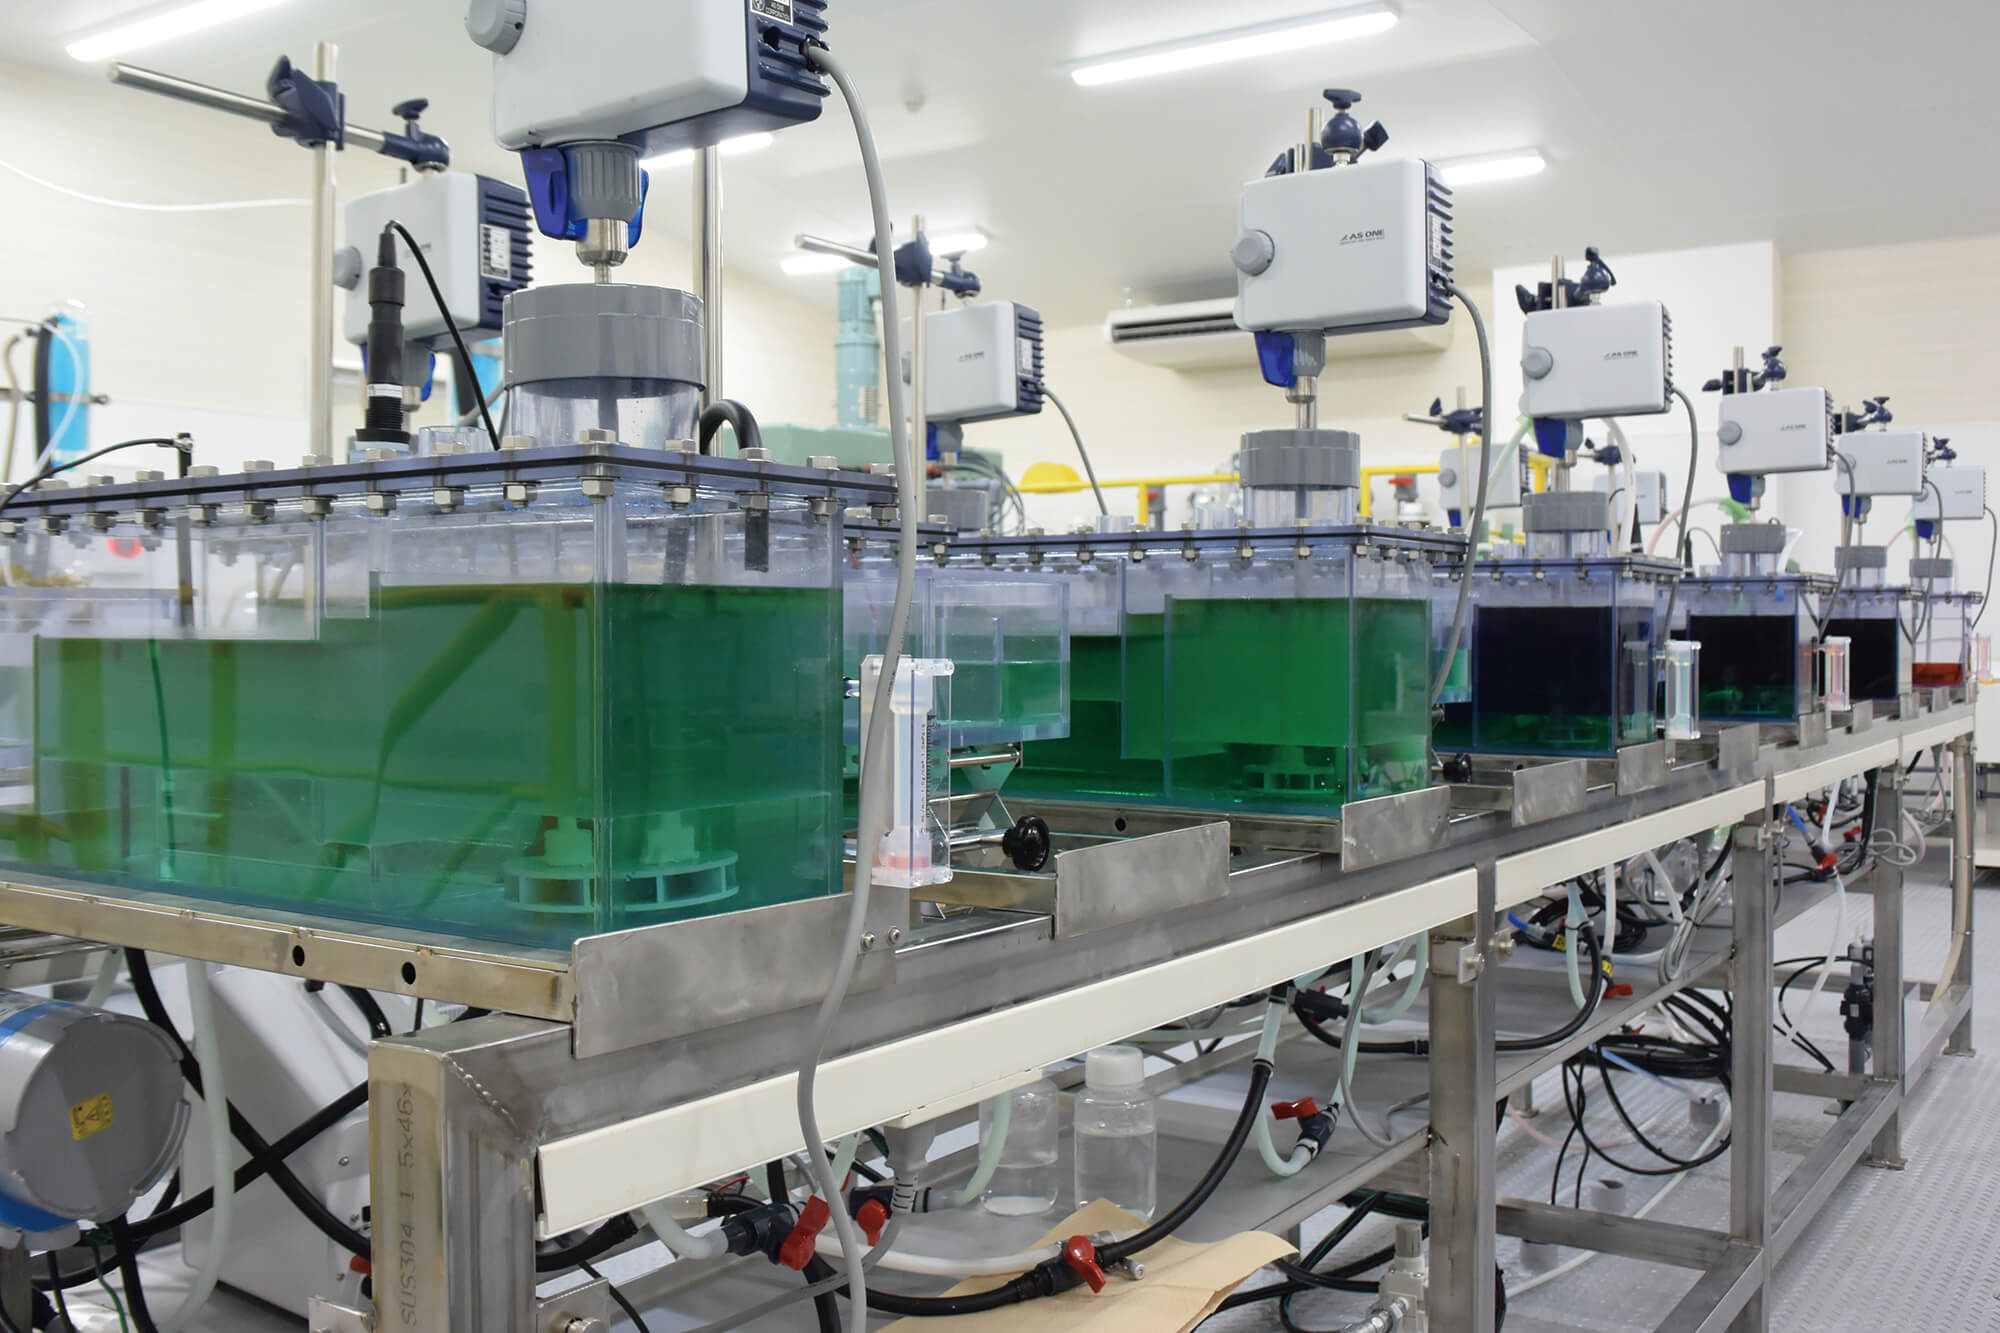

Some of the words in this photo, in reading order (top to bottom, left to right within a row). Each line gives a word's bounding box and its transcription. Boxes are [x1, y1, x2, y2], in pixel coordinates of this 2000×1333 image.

[1349, 231, 1363, 240] AS
[1365, 229, 1384, 238] ONE
[400, 1224, 417, 1327] SUS304
